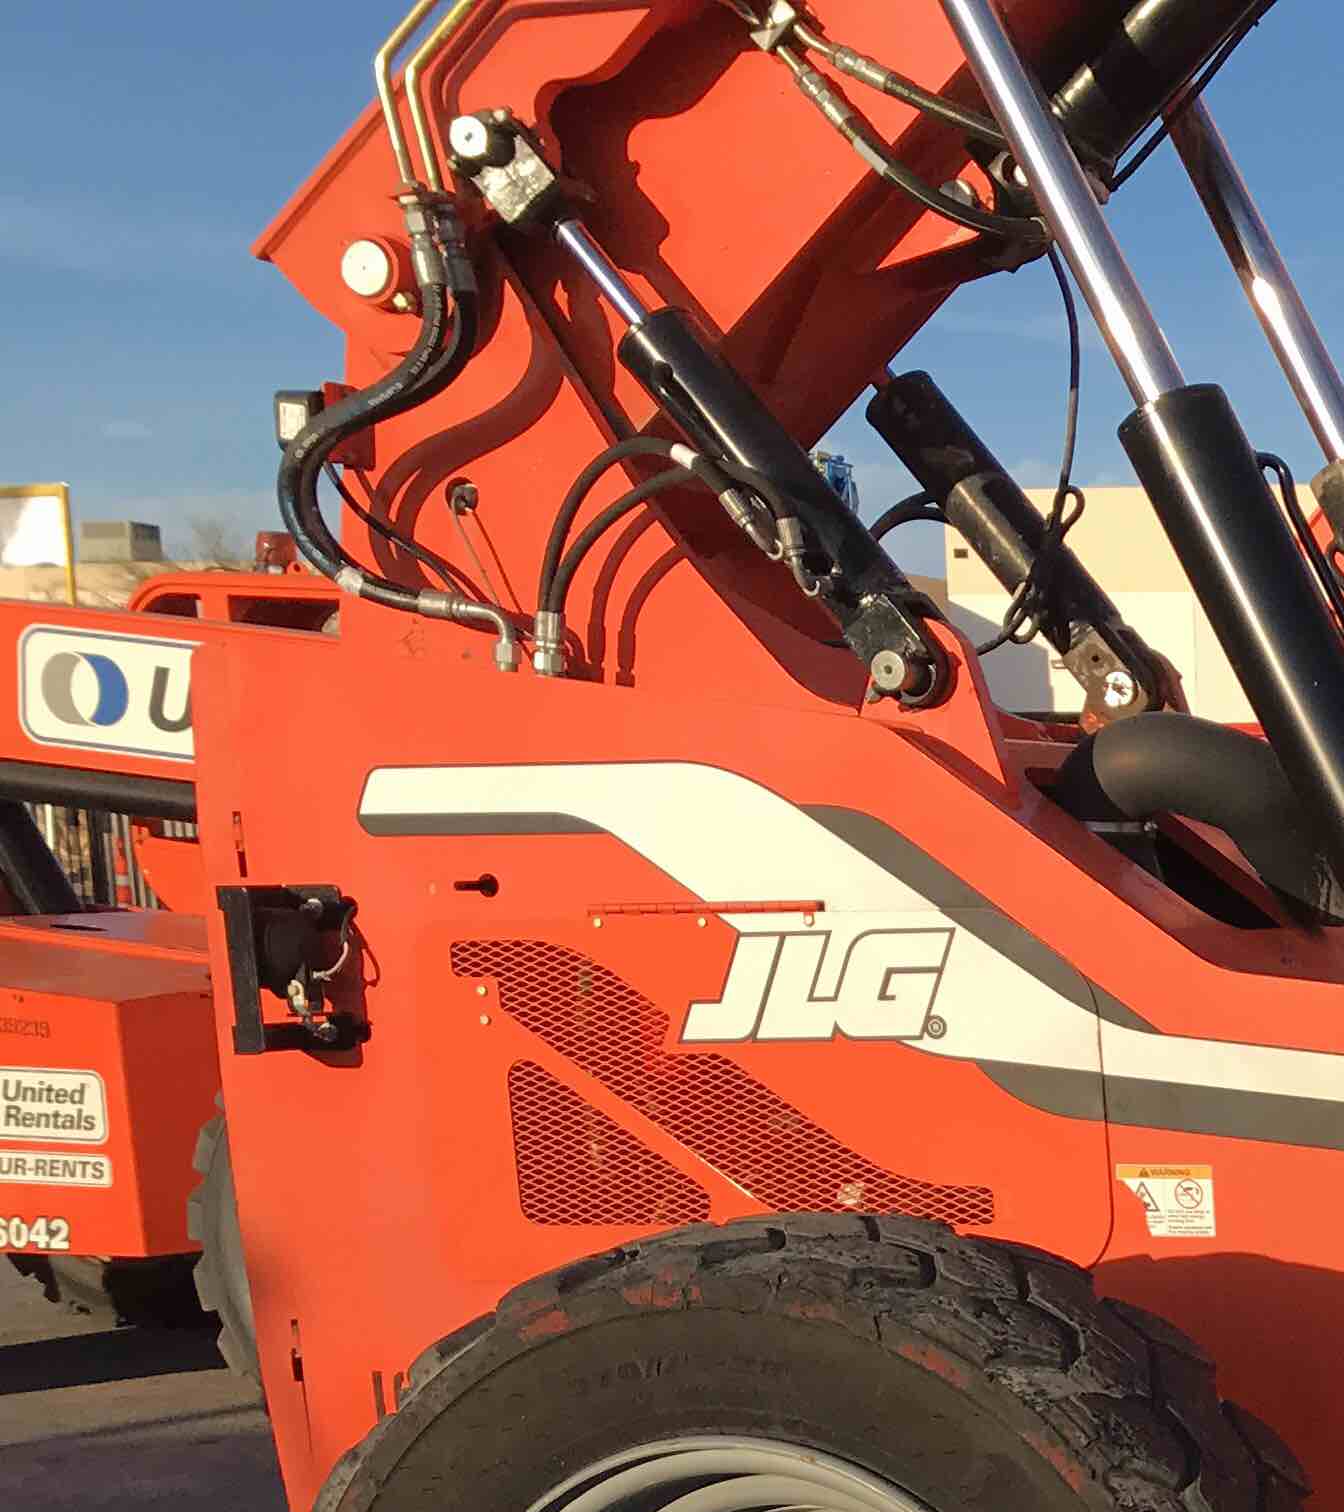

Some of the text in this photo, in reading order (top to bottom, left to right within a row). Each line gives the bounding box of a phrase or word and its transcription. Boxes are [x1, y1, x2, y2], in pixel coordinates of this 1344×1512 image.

[679, 927, 955, 1043] JLG
[2, 1079, 86, 1105] United
[4, 1105, 96, 1131] Rentals
